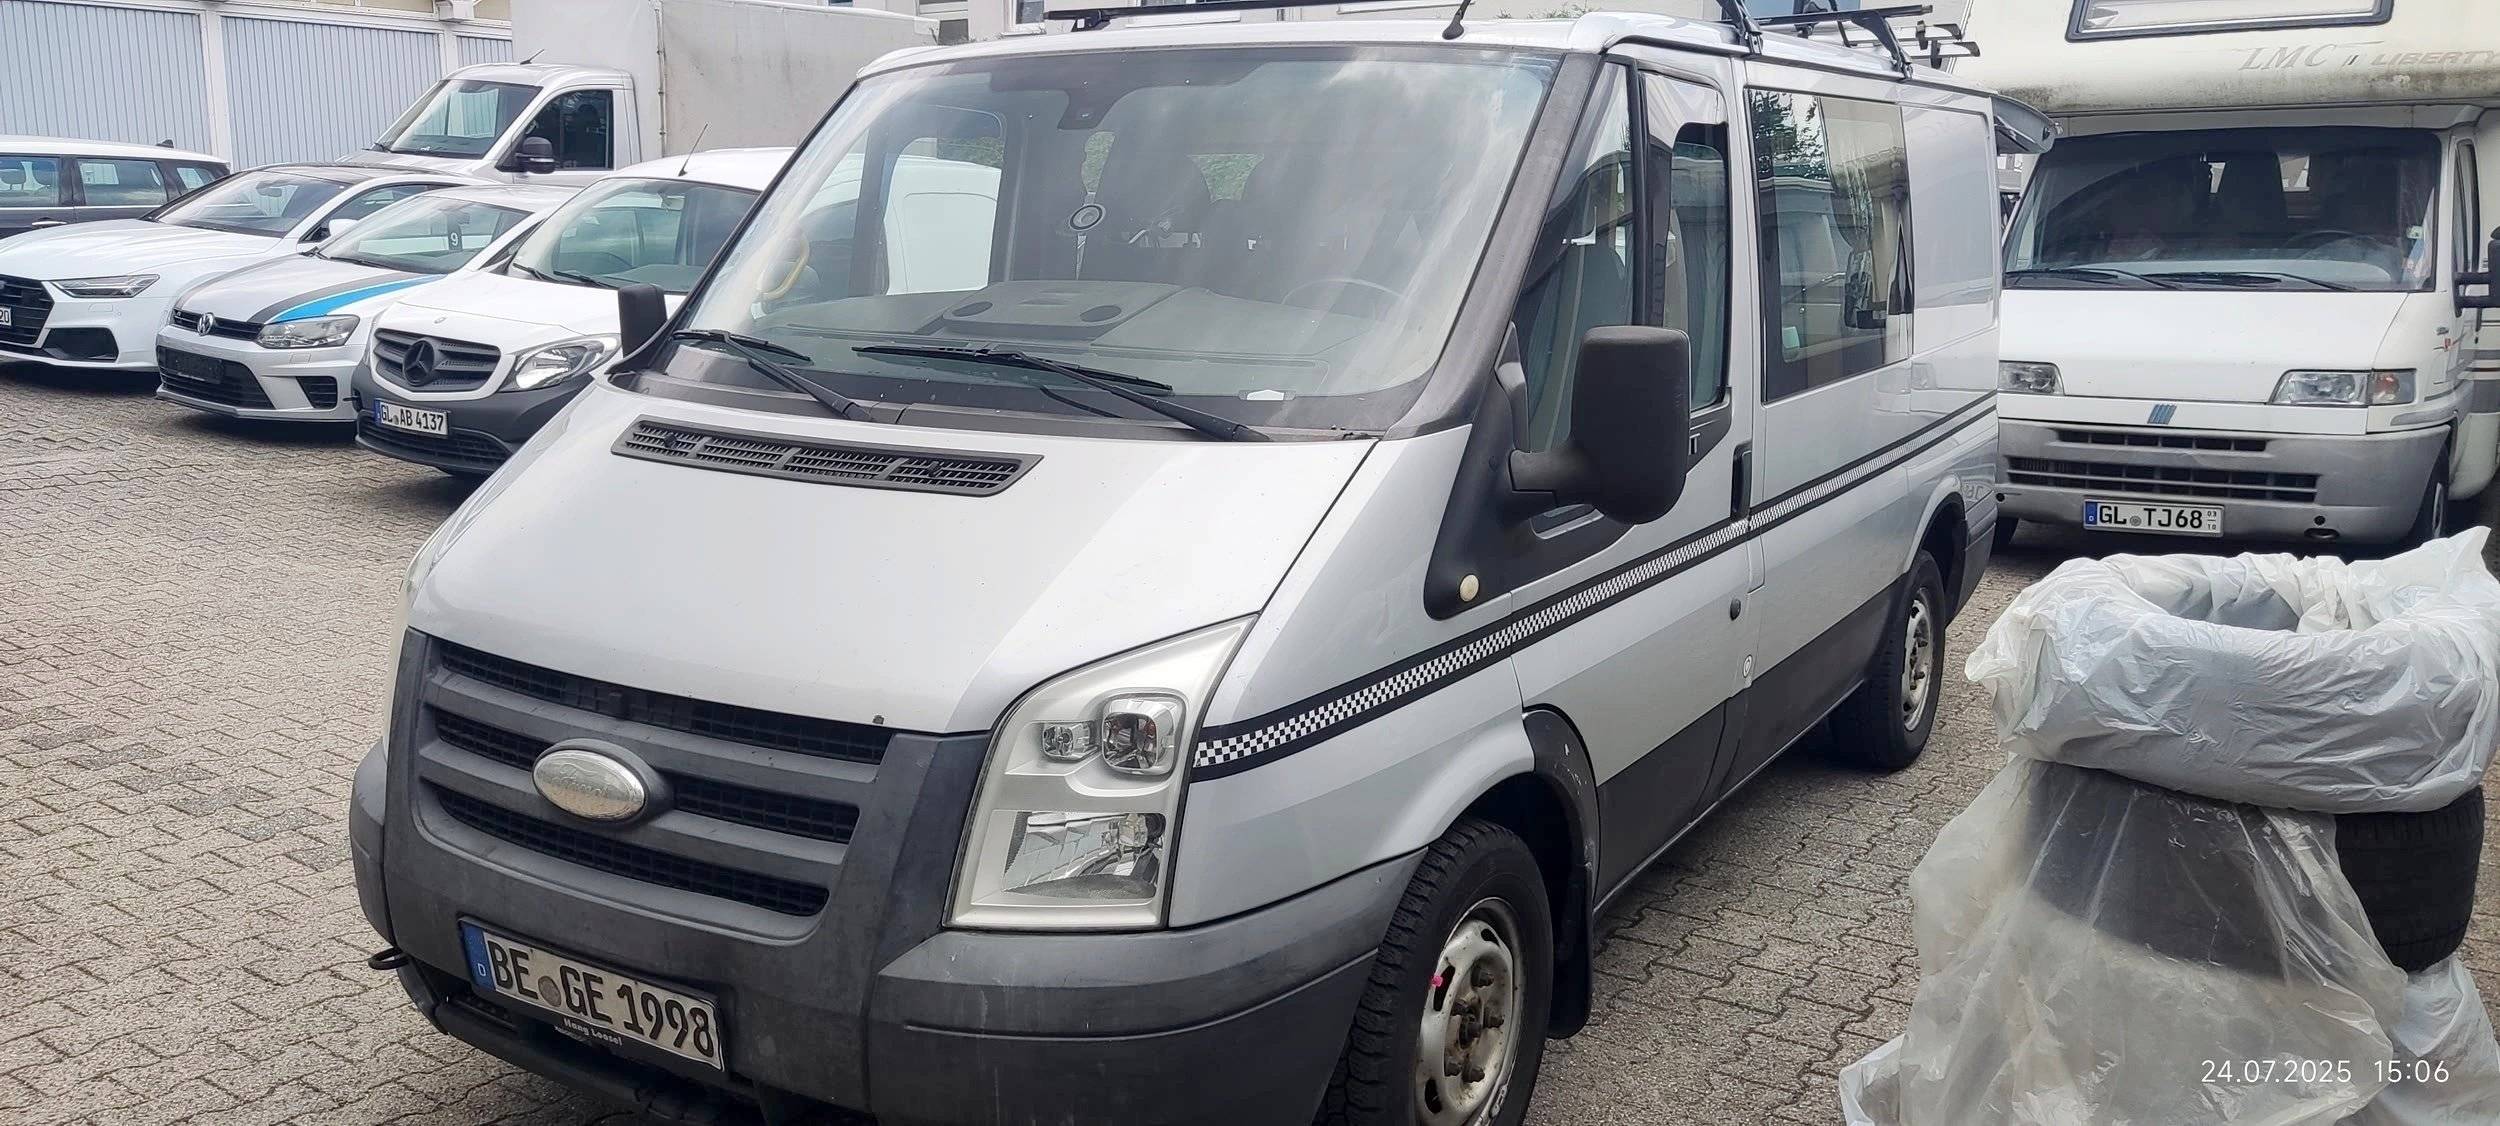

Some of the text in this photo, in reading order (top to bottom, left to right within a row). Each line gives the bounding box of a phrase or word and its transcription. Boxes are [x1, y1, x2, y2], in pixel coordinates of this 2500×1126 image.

[2237, 43, 2500, 71] LMC LIBERTY
[450, 232, 459, 247] 9
[380, 404, 444, 432] GL AB 4137
[2099, 505, 2128, 525] GL
[477, 939, 715, 1058] D BE GE 1998
